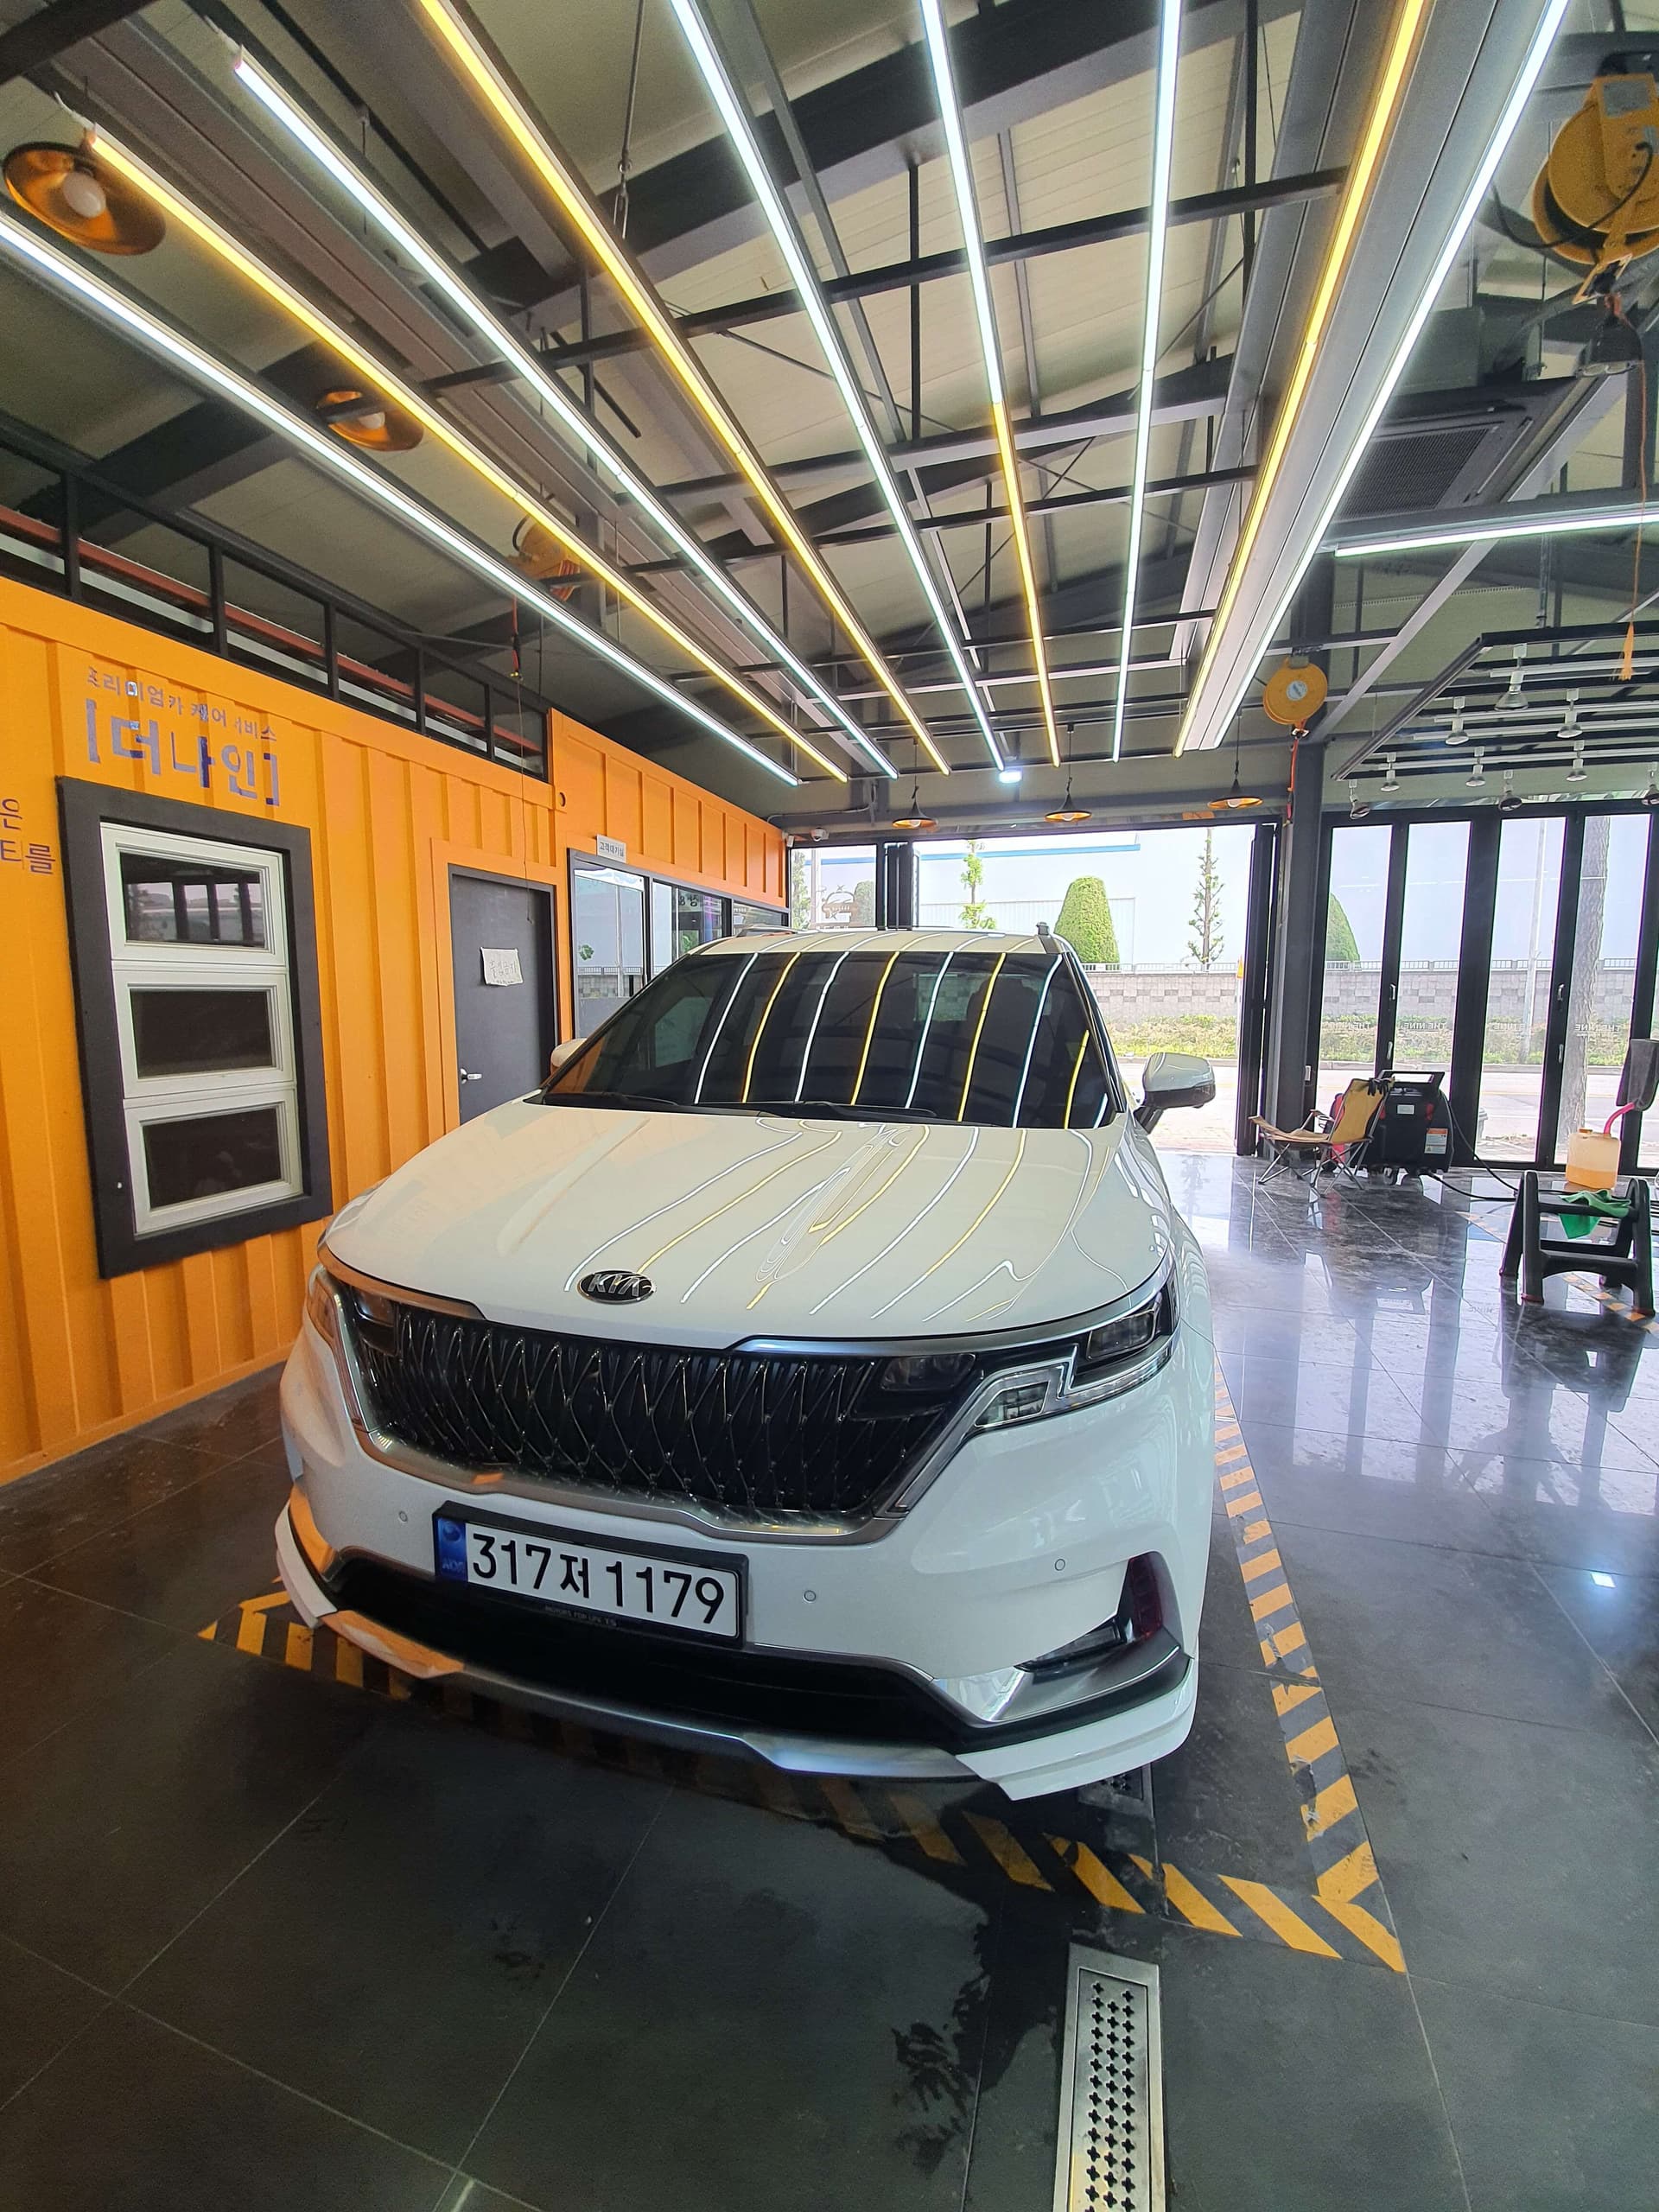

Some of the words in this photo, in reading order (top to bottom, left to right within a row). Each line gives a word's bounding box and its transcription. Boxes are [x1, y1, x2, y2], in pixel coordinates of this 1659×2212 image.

[588, 1274, 640, 1297] KIA
[473, 1533, 589, 1599] 317저
[606, 1560, 725, 1624] 1179
